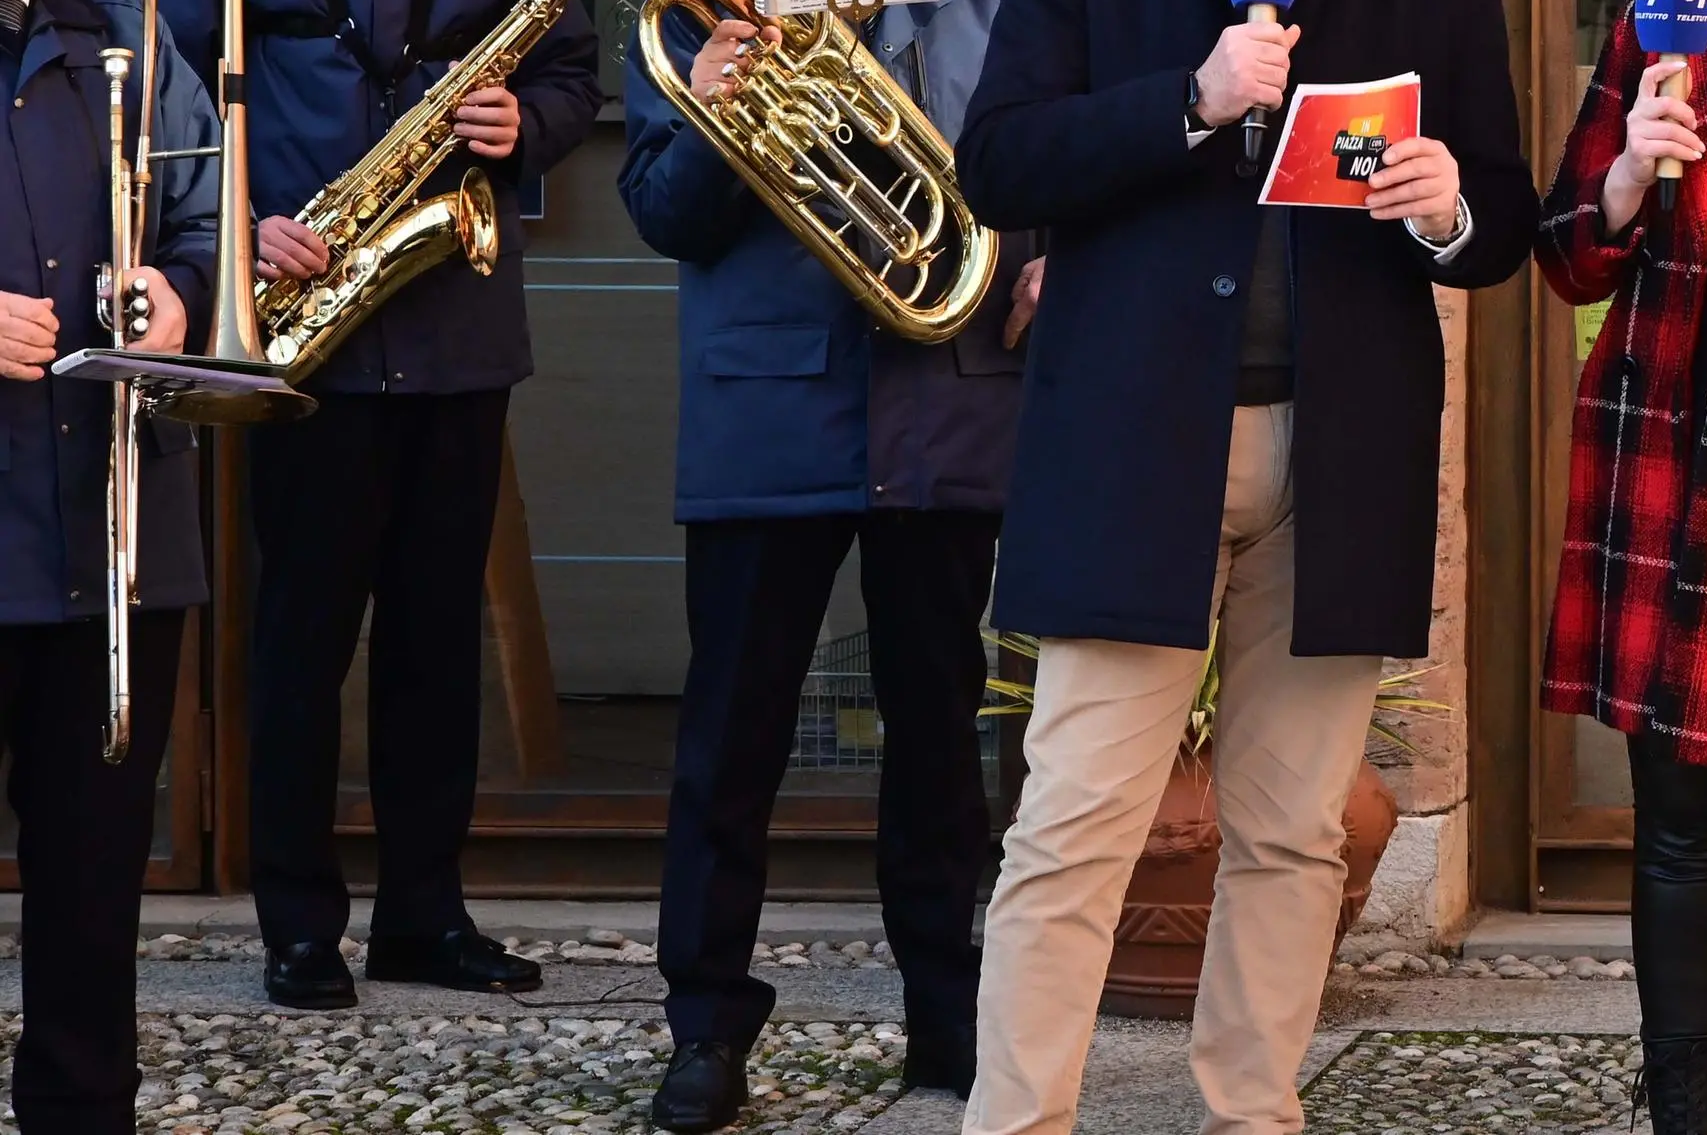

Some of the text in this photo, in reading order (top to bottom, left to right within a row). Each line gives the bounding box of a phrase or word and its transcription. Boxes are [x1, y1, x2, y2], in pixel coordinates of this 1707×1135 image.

[1361, 119, 1371, 133] IN
[1334, 136, 1364, 151] PIAZZA
[1349, 156, 1378, 177] NOI
